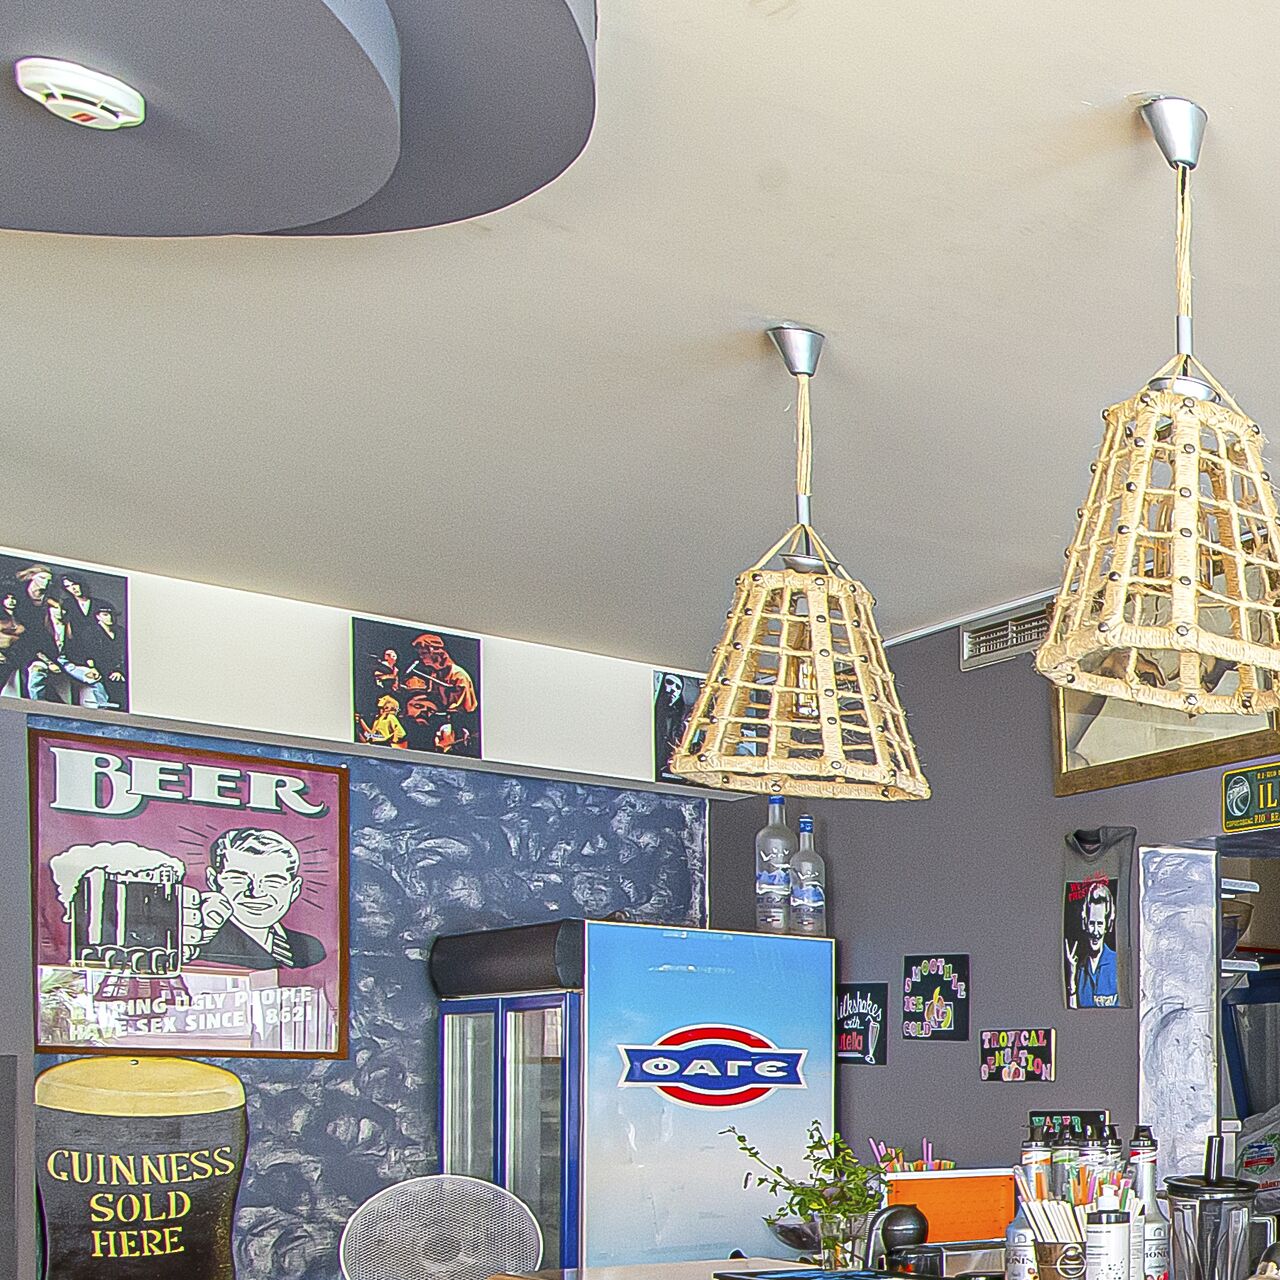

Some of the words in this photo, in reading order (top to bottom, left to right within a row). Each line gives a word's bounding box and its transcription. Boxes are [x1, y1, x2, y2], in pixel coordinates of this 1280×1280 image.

[50, 747, 329, 817] BEER
[903, 996, 923, 1013] ICE
[136, 1016, 176, 1033] SEX
[185, 1011, 244, 1030] SINCE
[903, 1021, 932, 1037] COLD
[982, 1031, 1047, 1049] TROPICAL
[47, 1146, 236, 1186] GUINNESS
[90, 1191, 191, 1222] SOLD
[91, 1226, 185, 1258] HERE
